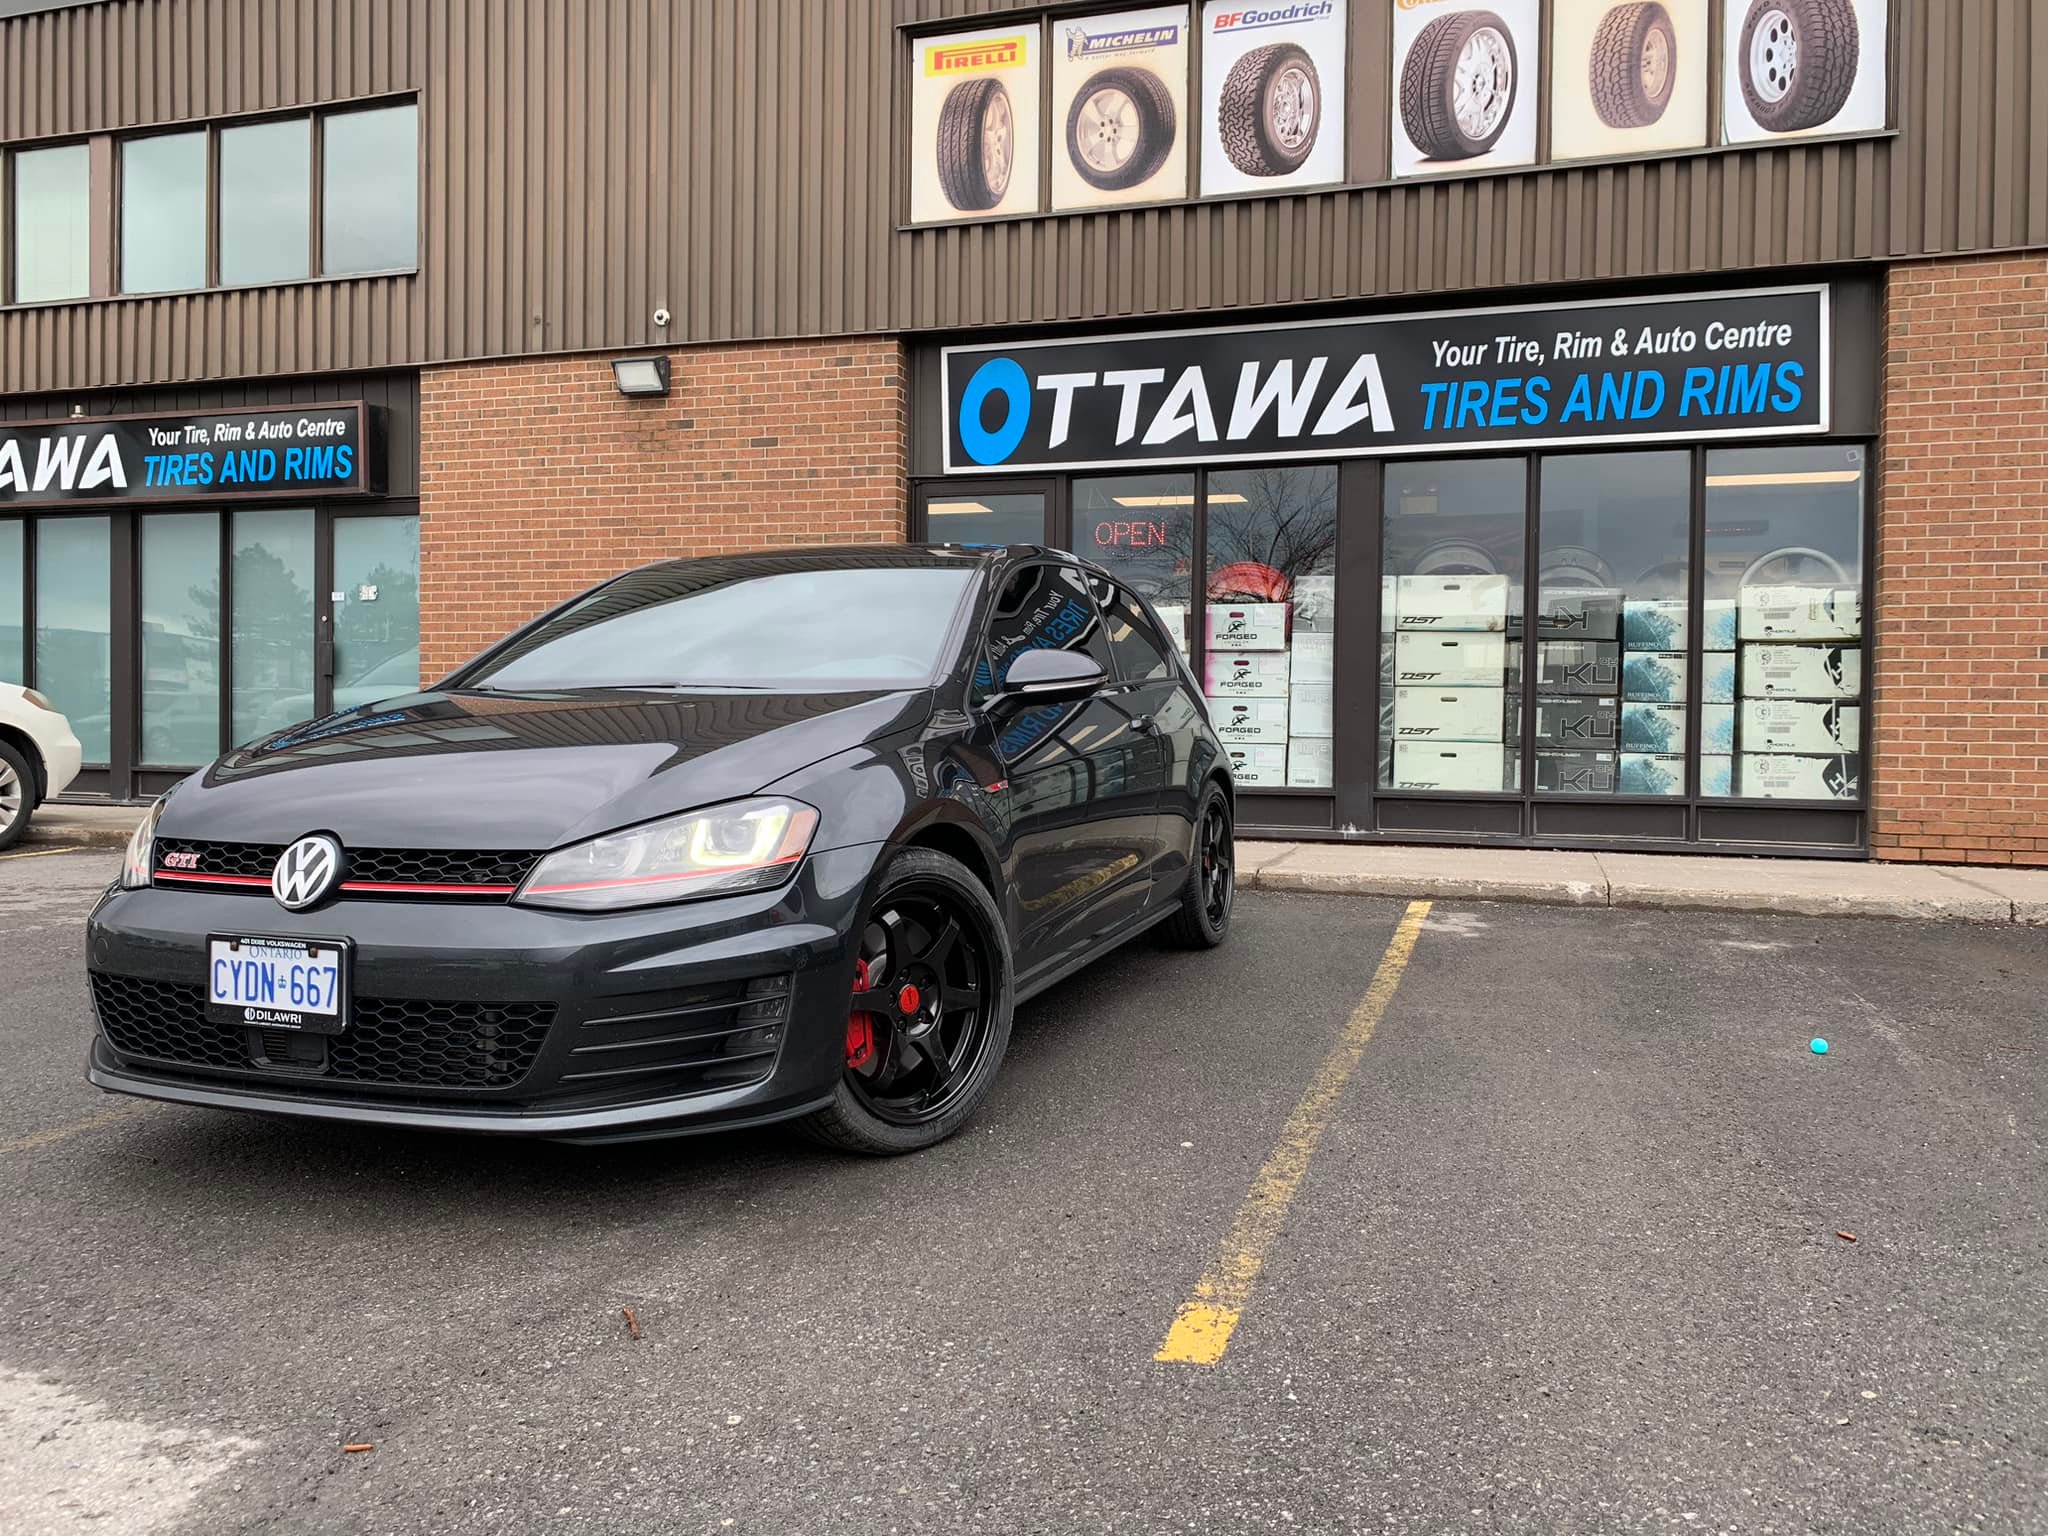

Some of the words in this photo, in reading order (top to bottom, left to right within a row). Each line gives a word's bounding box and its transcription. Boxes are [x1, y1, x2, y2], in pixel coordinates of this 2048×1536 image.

[1214, 1, 1332, 29] BFGoodrich
[1088, 29, 1175, 49] MICHELIN
[934, 42, 1017, 70] PIRELLI
[1432, 341, 1487, 368] Your
[1494, 336, 1546, 366] Tire,
[1553, 331, 1602, 360] Rim
[1610, 328, 1629, 357] &
[1634, 325, 1697, 355] Auto
[1705, 320, 1792, 351] Centre
[1420, 376, 1551, 430] TIRES
[1559, 370, 1666, 423] AND
[1679, 360, 1805, 417] RIMS
[959, 353, 1396, 466] OTTAWA
[148, 427, 180, 448] Your
[184, 425, 210, 447] Tire,
[214, 422, 241, 443] Rim
[245, 421, 256, 441] &
[258, 421, 293, 441] Auto
[297, 418, 346, 438] Centre
[144, 451, 214, 488] TIRES
[219, 448, 276, 485] AND
[284, 444, 353, 481] RIMS
[1095, 521, 1167, 546] OPEN
[164, 852, 200, 869] GTI
[249, 945, 302, 960] ONTARIO
[266, 940, 306, 948] VOLKSWAGEN
[214, 959, 275, 1003] CYDN
[290, 965, 336, 1008] 667
[256, 1010, 302, 1024] DILAWRI
